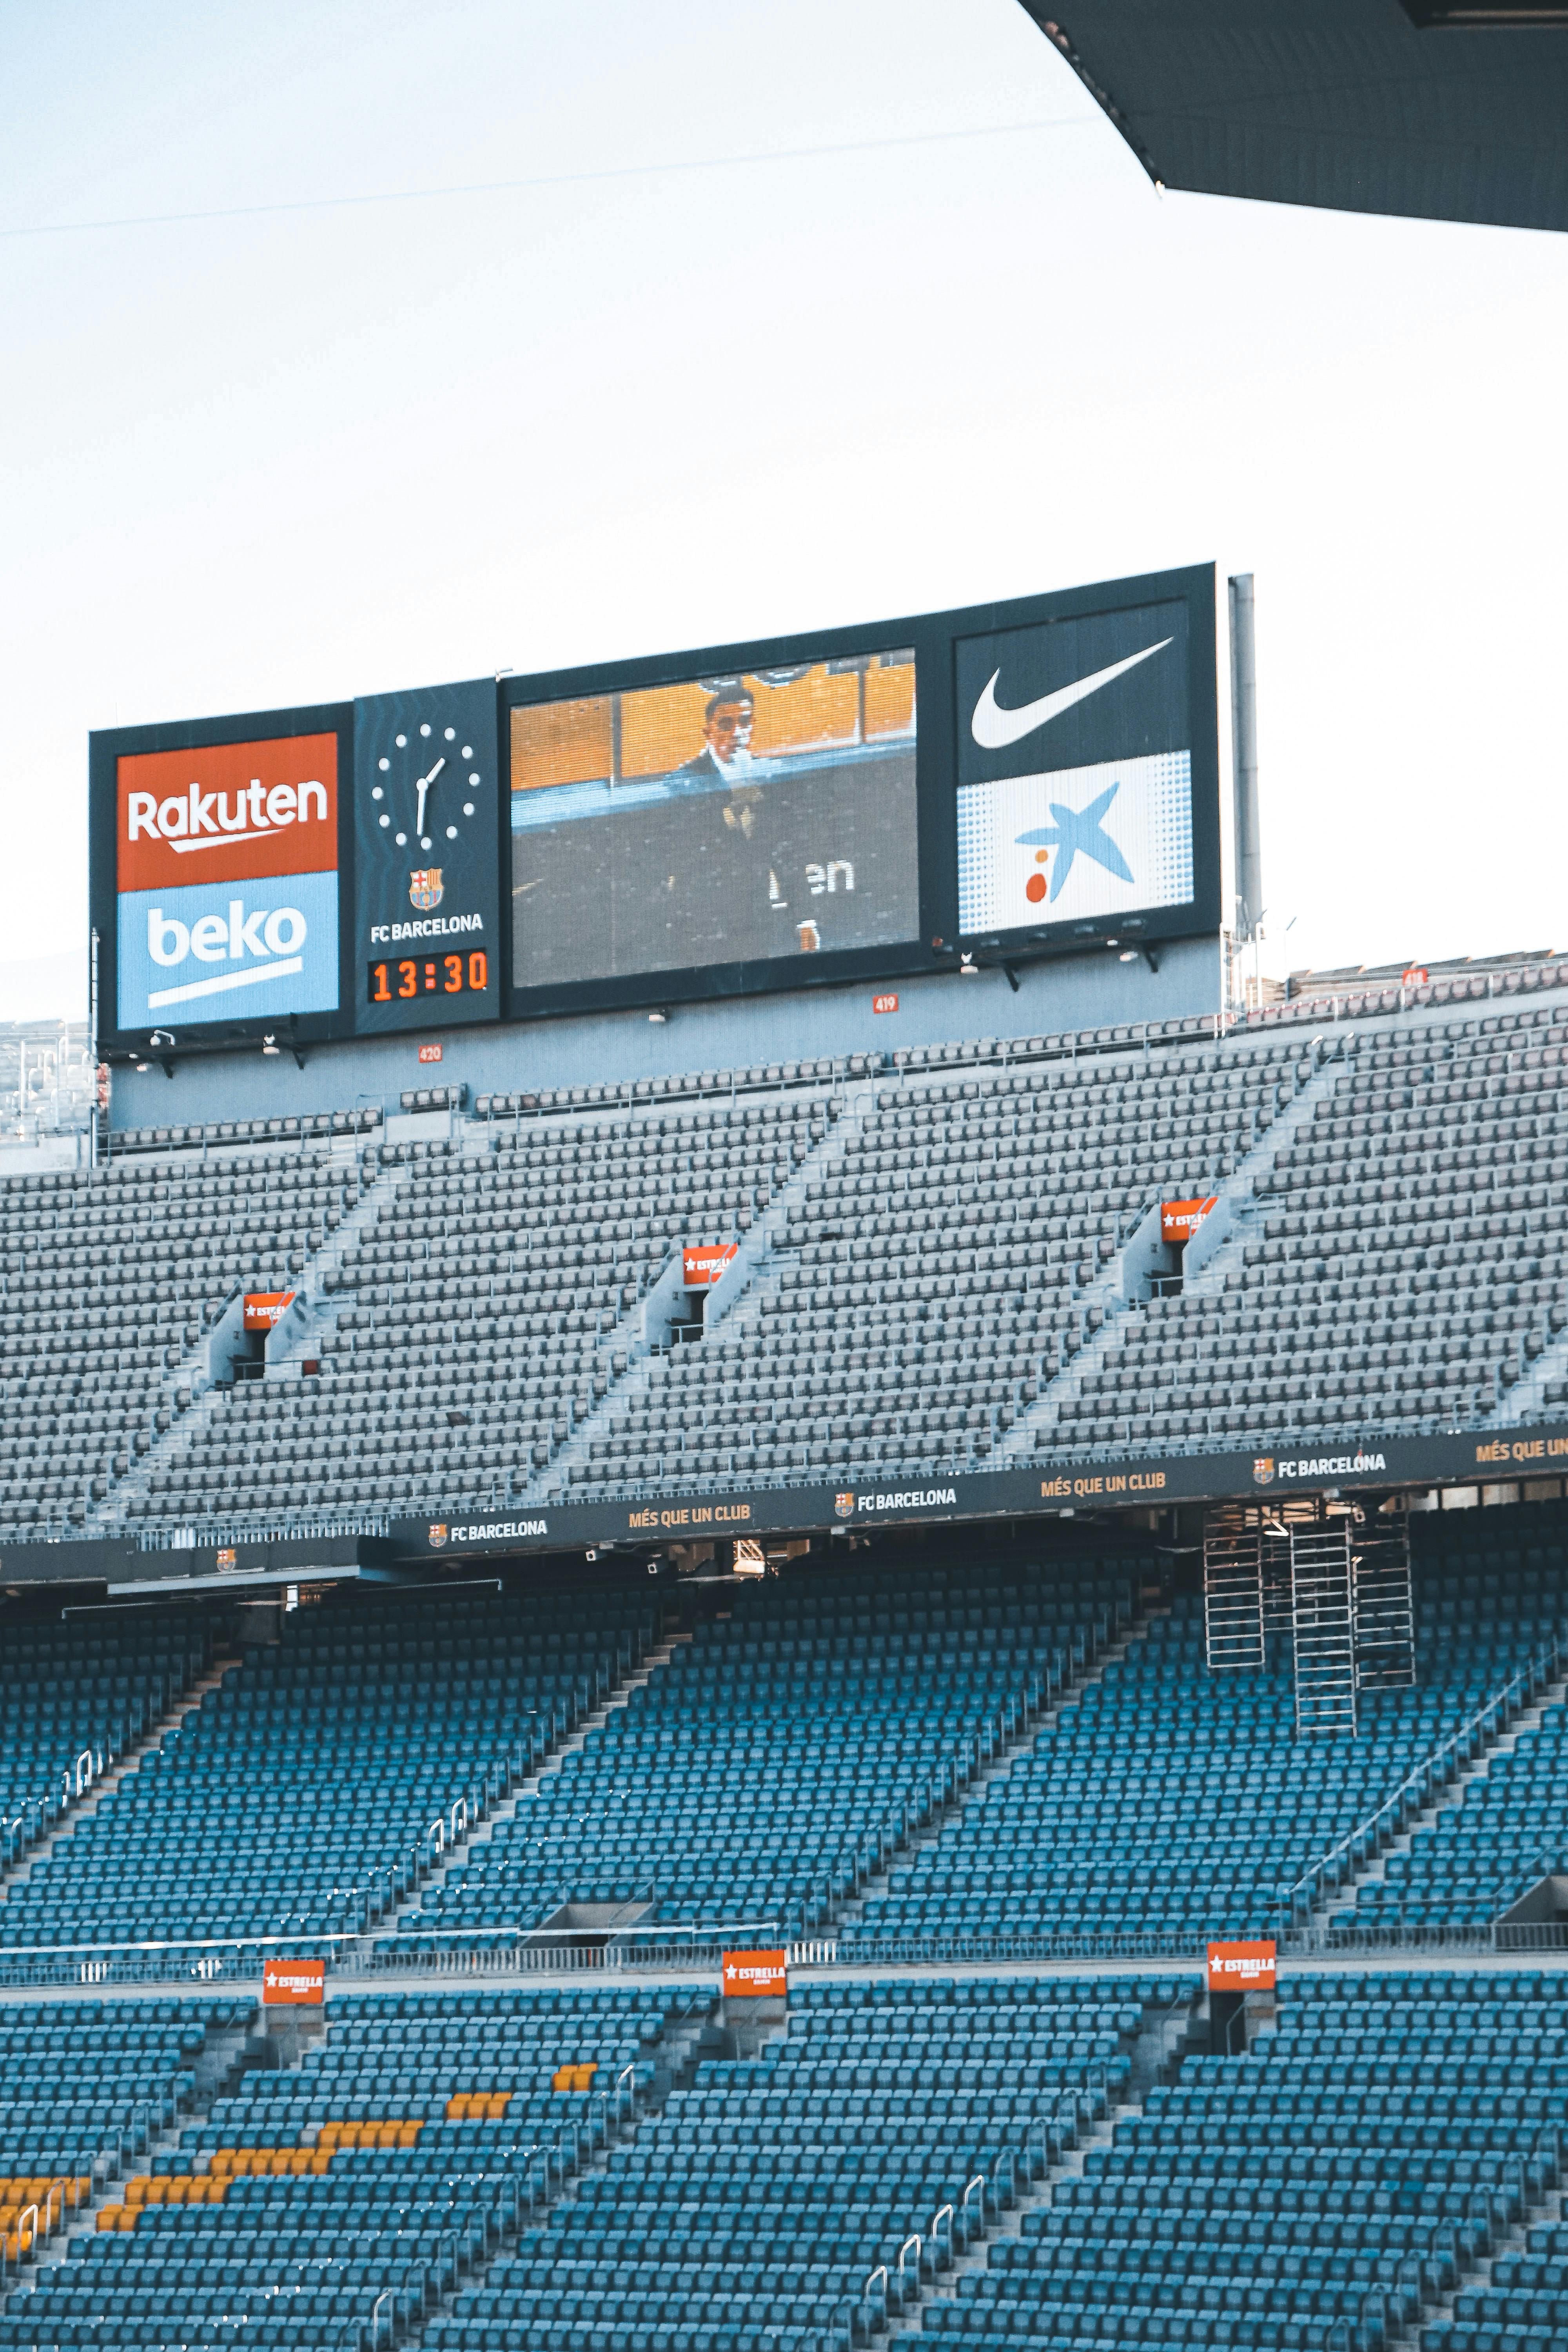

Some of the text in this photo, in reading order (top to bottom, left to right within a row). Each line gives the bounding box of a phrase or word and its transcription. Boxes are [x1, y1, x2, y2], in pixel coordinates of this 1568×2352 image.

[128, 778, 327, 841] Rakuten
[147, 899, 307, 967] beko
[371, 913, 483, 943] FC BARCELONA
[374, 952, 487, 1002] 13:30
[875, 996, 896, 1011] 419
[419, 1046, 441, 1060] 420
[1475, 1439, 1510, 1462] MÉS
[1512, 1440, 1546, 1462] QUE
[1278, 1454, 1386, 1478] FC BARCELONA
[1041, 1472, 1166, 1497] MÉS QUE UN CLUB
[858, 1488, 957, 1512] FC BARCELONA
[628, 1504, 750, 1528] MÉS QUE UN CLUB
[451, 1519, 548, 1542] FC BARCELONA
[739, 1966, 786, 1979] ESTRELLA
[1224, 1958, 1274, 1972] ESTRELLA
[278, 1976, 323, 1987] ESTRELLA
